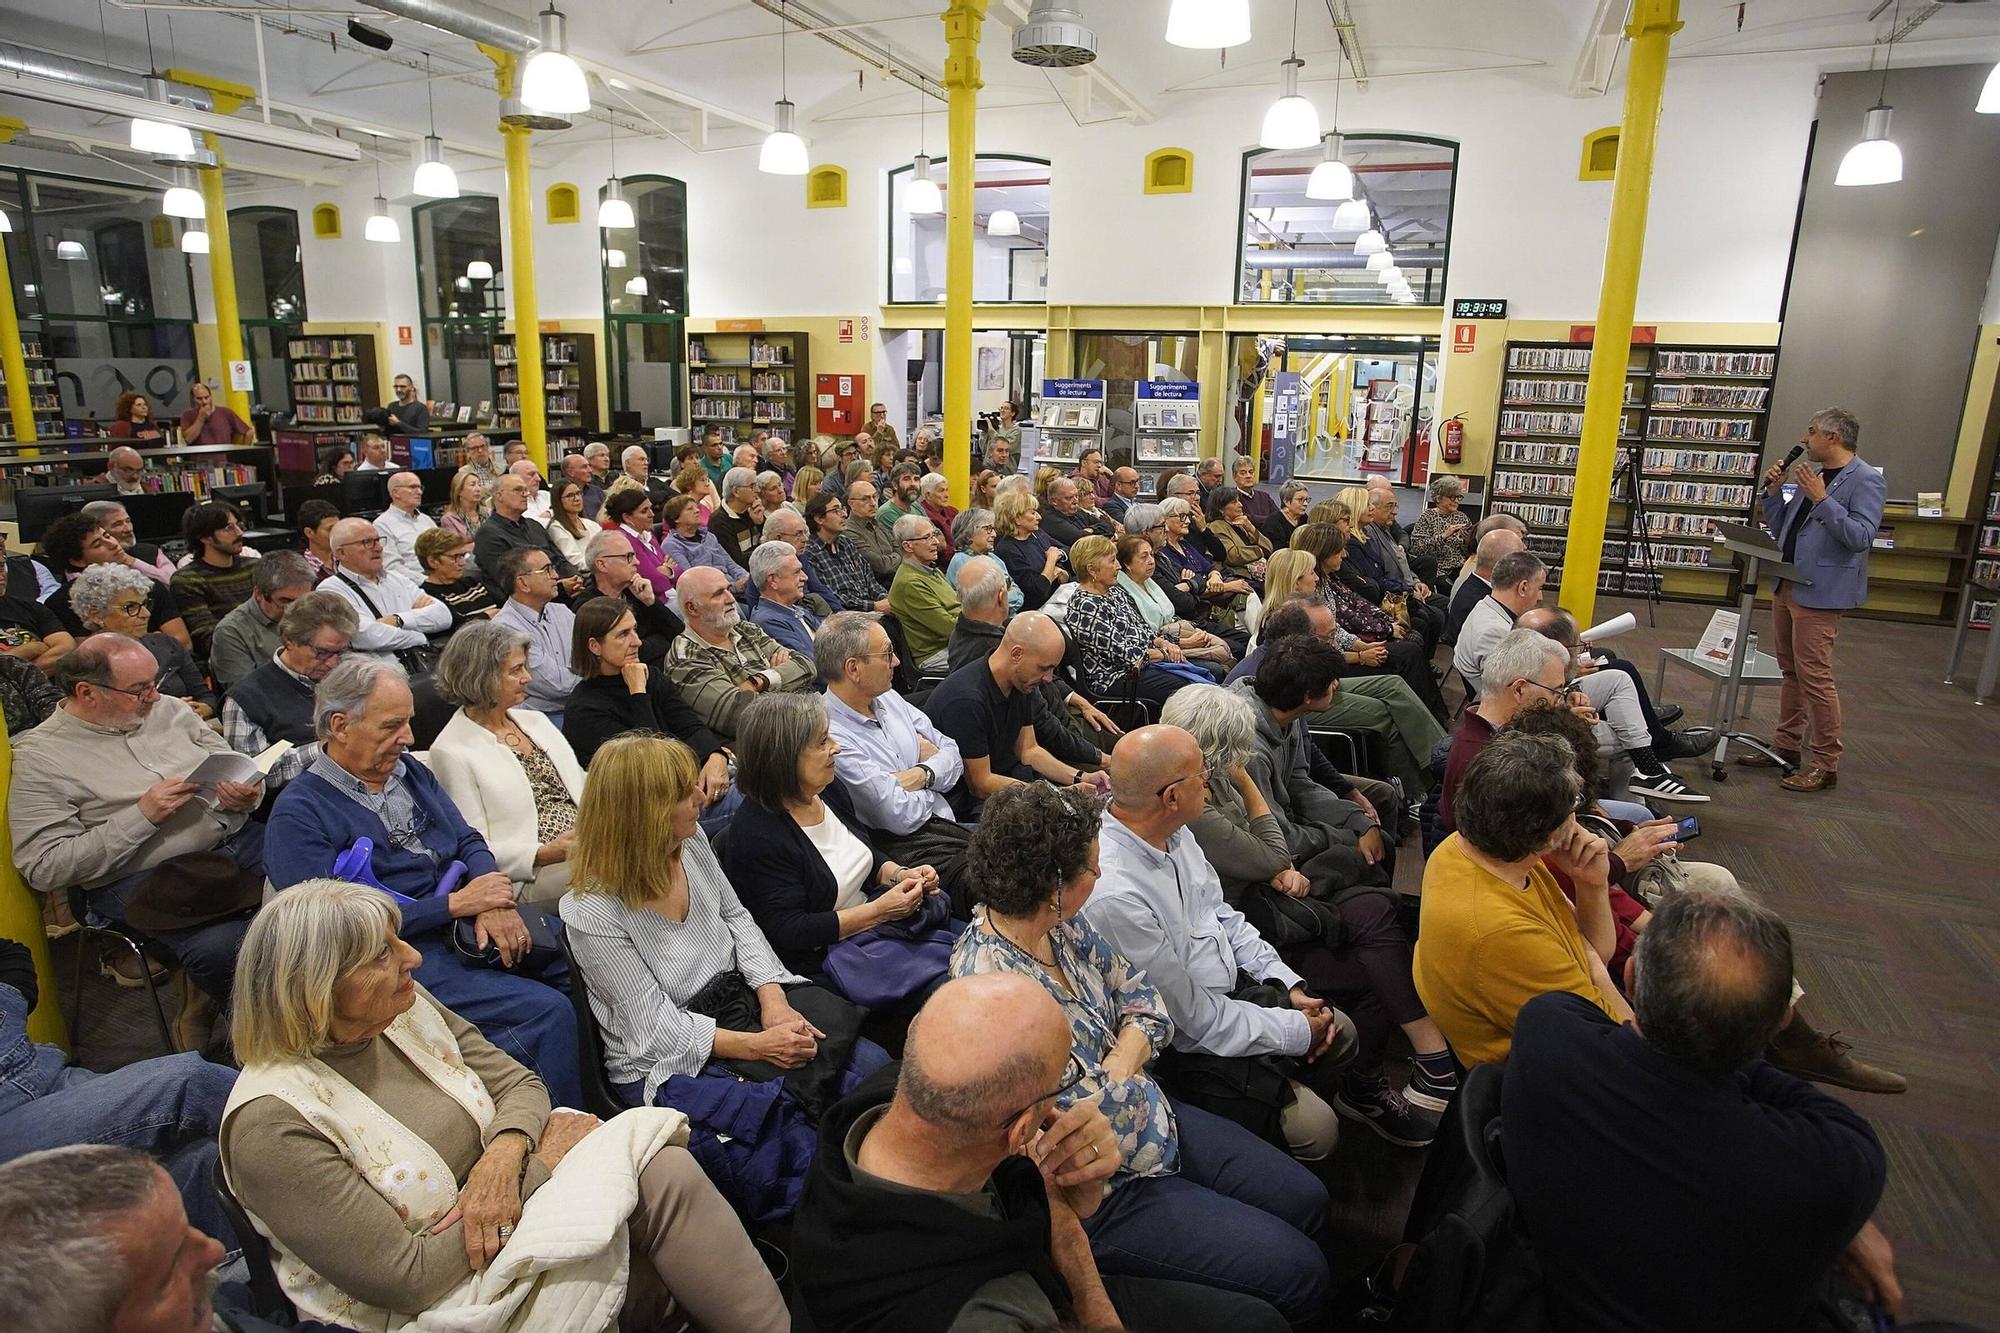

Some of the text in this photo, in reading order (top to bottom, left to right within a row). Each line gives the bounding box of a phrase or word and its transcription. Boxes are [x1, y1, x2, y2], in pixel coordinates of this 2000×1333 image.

[1456, 302, 1503, 313] 19:31:43
[1054, 381, 1092, 389] Suggeriments
[1149, 383, 1188, 391] Suggeriments
